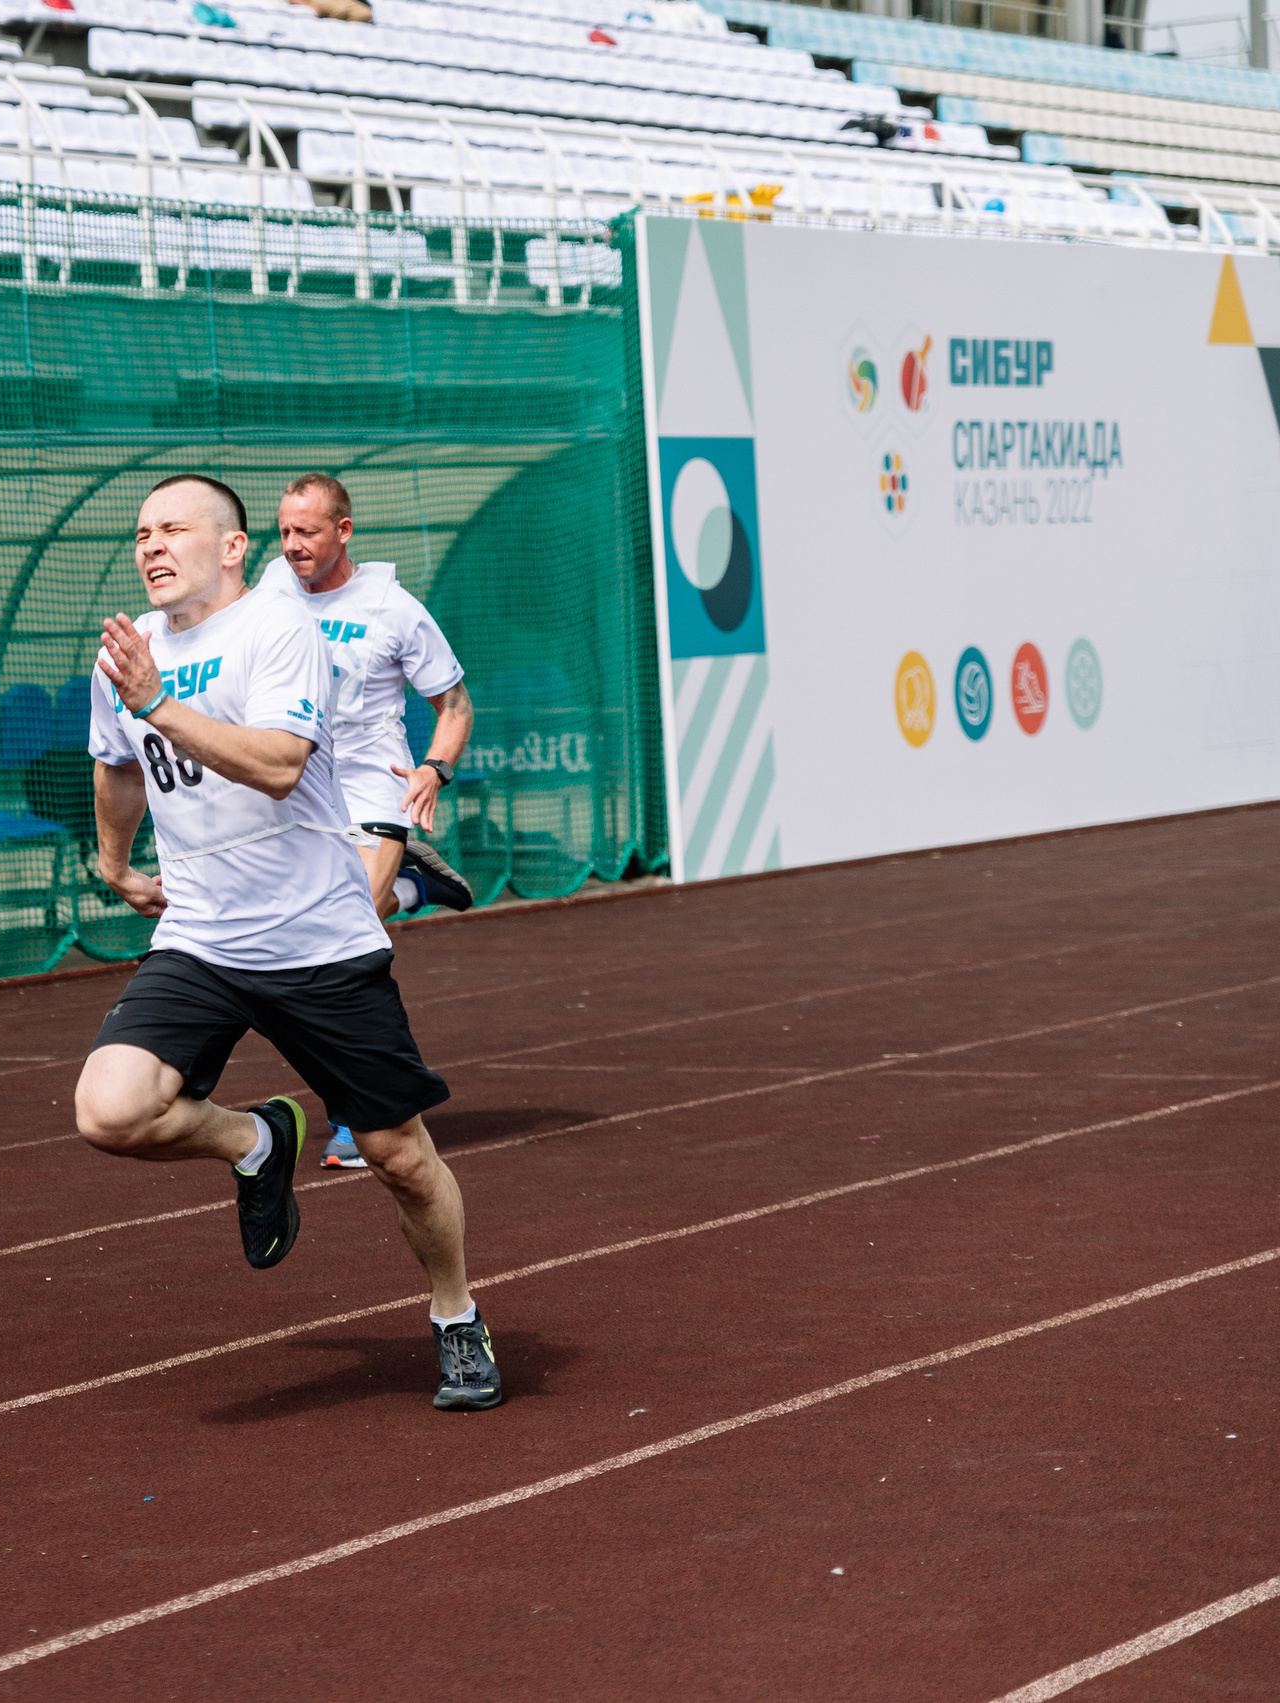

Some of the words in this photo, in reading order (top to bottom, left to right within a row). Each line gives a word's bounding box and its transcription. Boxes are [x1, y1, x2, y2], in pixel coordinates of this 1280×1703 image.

[949, 337, 1054, 387] СИБУР
[952, 419, 1124, 479] СПАРТАКИАДА
[954, 479, 1041, 526] КАЗАНЬ
[1046, 477, 1094, 524] 2022
